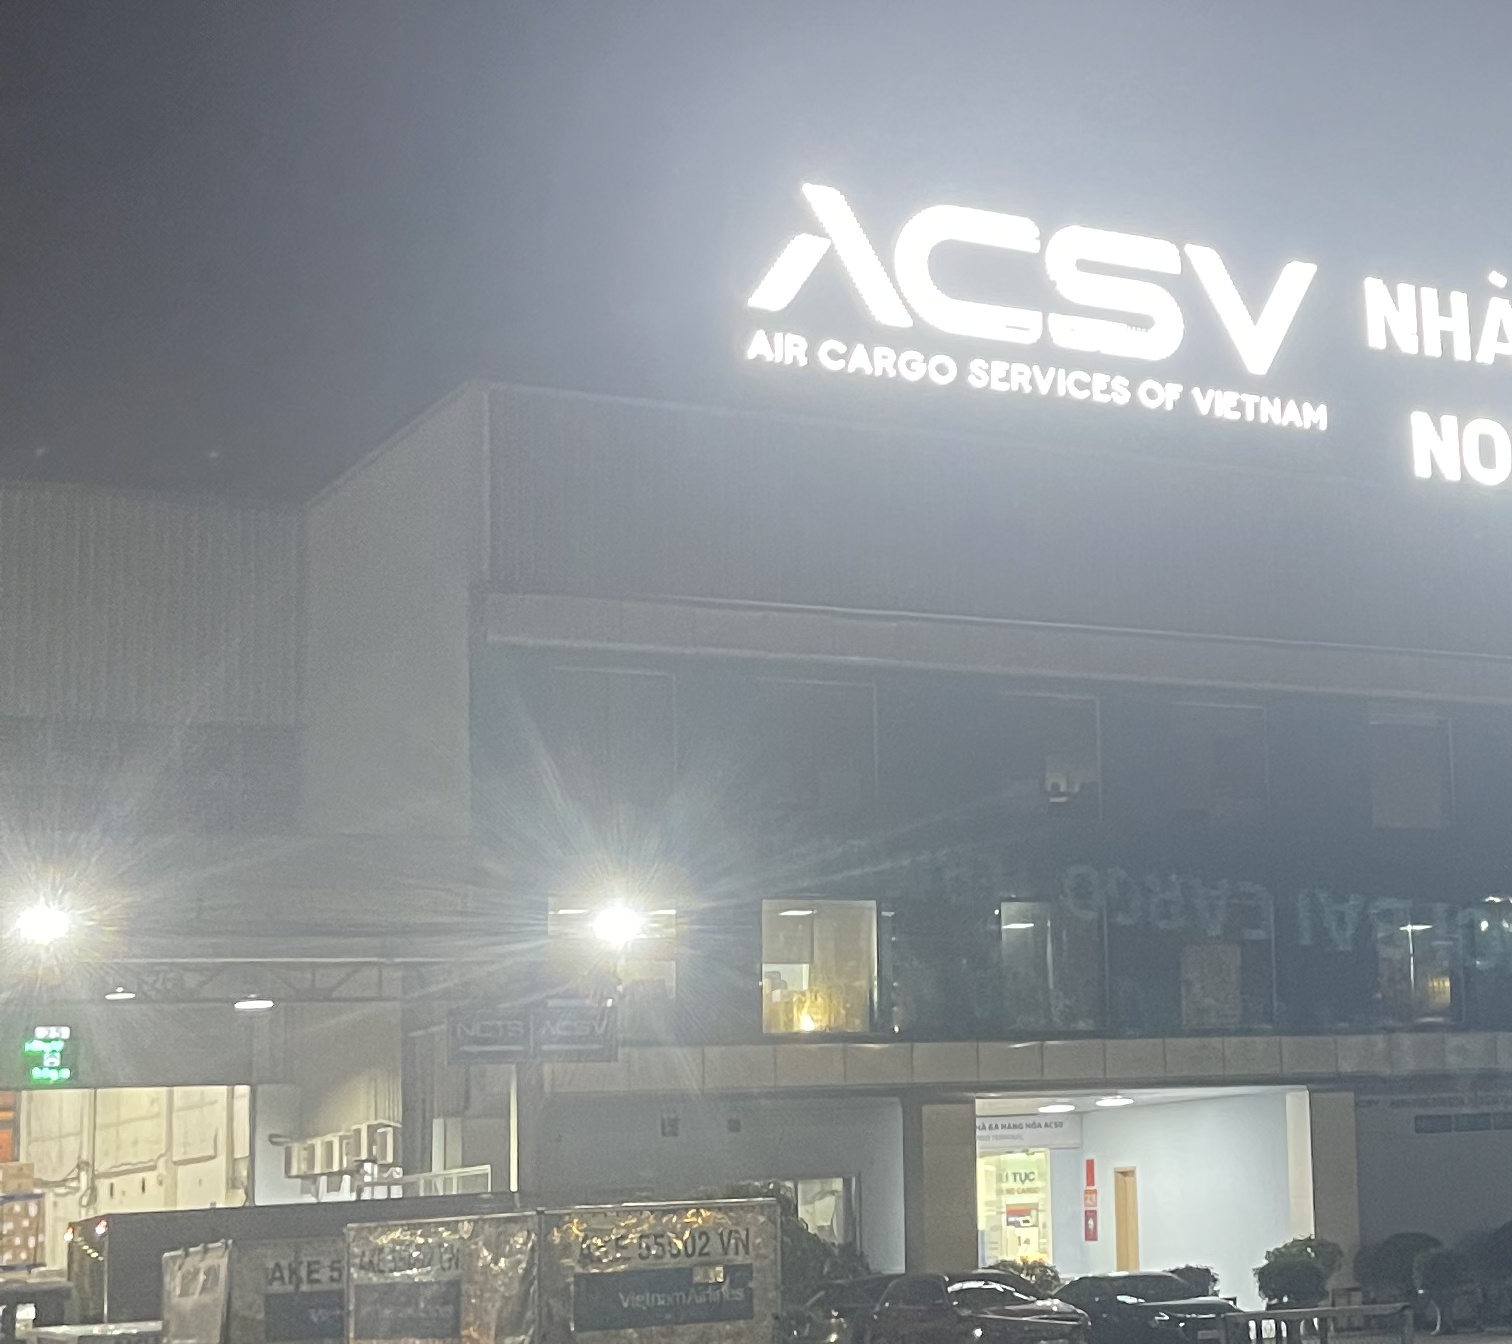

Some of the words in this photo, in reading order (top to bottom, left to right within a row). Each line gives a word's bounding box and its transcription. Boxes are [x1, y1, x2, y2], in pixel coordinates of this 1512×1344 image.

[747, 181, 1318, 376] ACSV
[746, 329, 808, 367] AIR
[817, 338, 958, 386] CARGO
[967, 358, 1132, 406] SERVICES
[1137, 378, 1184, 411] OF
[1191, 386, 1328, 431] VIETNAM
[1012, 1171, 1036, 1184] TỤC
[719, 1227, 750, 1256] VN
[269, 1260, 322, 1286] AKE
